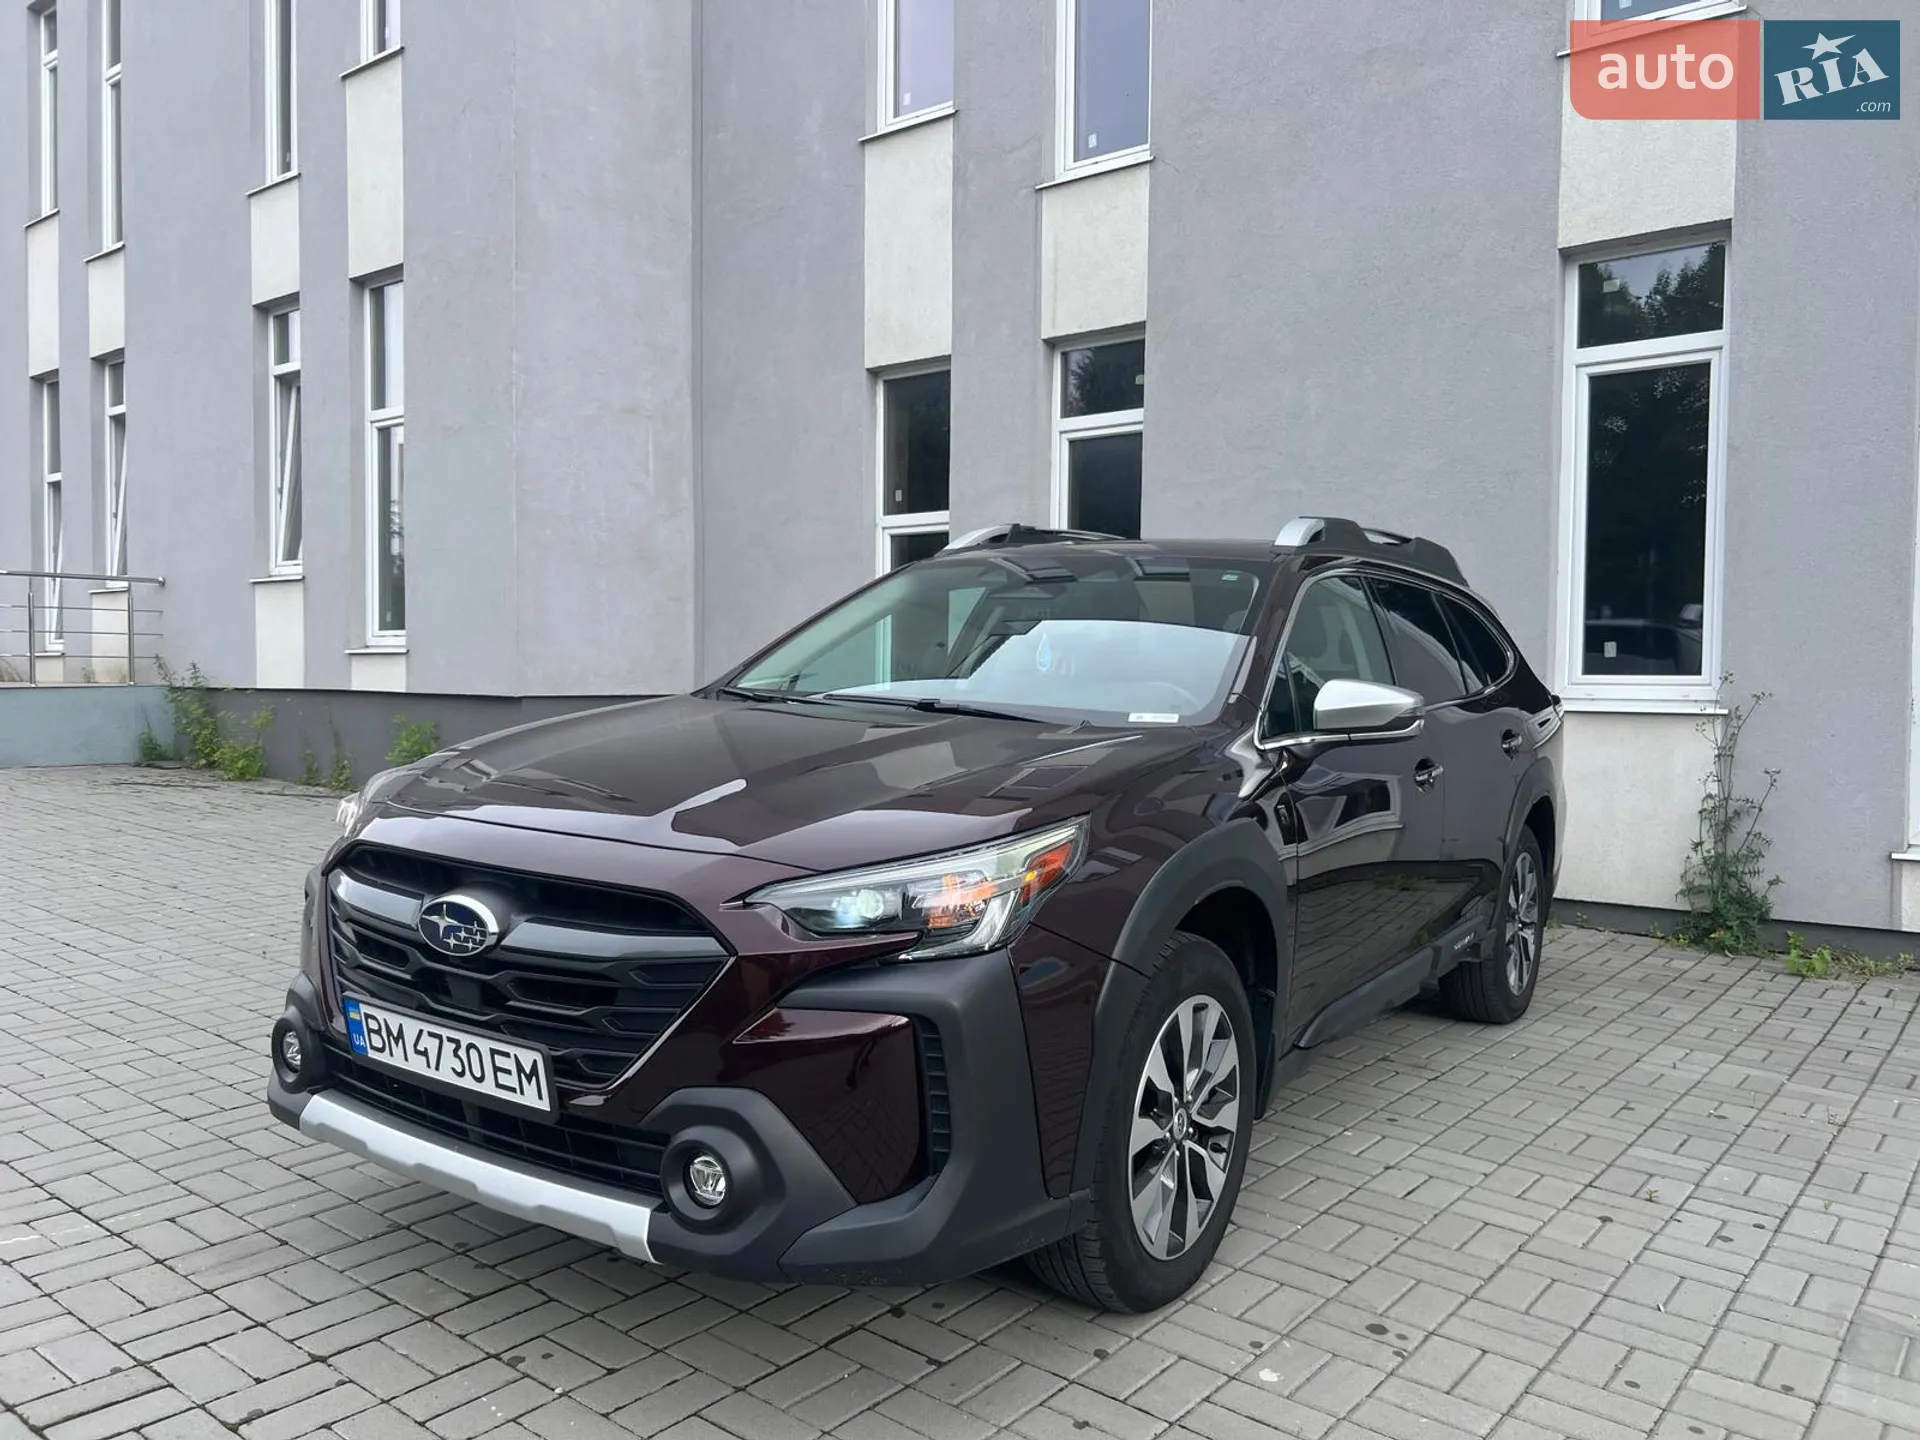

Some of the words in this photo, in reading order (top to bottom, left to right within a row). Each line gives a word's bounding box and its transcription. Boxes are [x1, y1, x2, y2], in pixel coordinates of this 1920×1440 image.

[352, 1032, 366, 1048] UA
[363, 1011, 410, 1062] BM
[413, 1028, 486, 1084] 4730
[489, 1046, 544, 1101] EM
